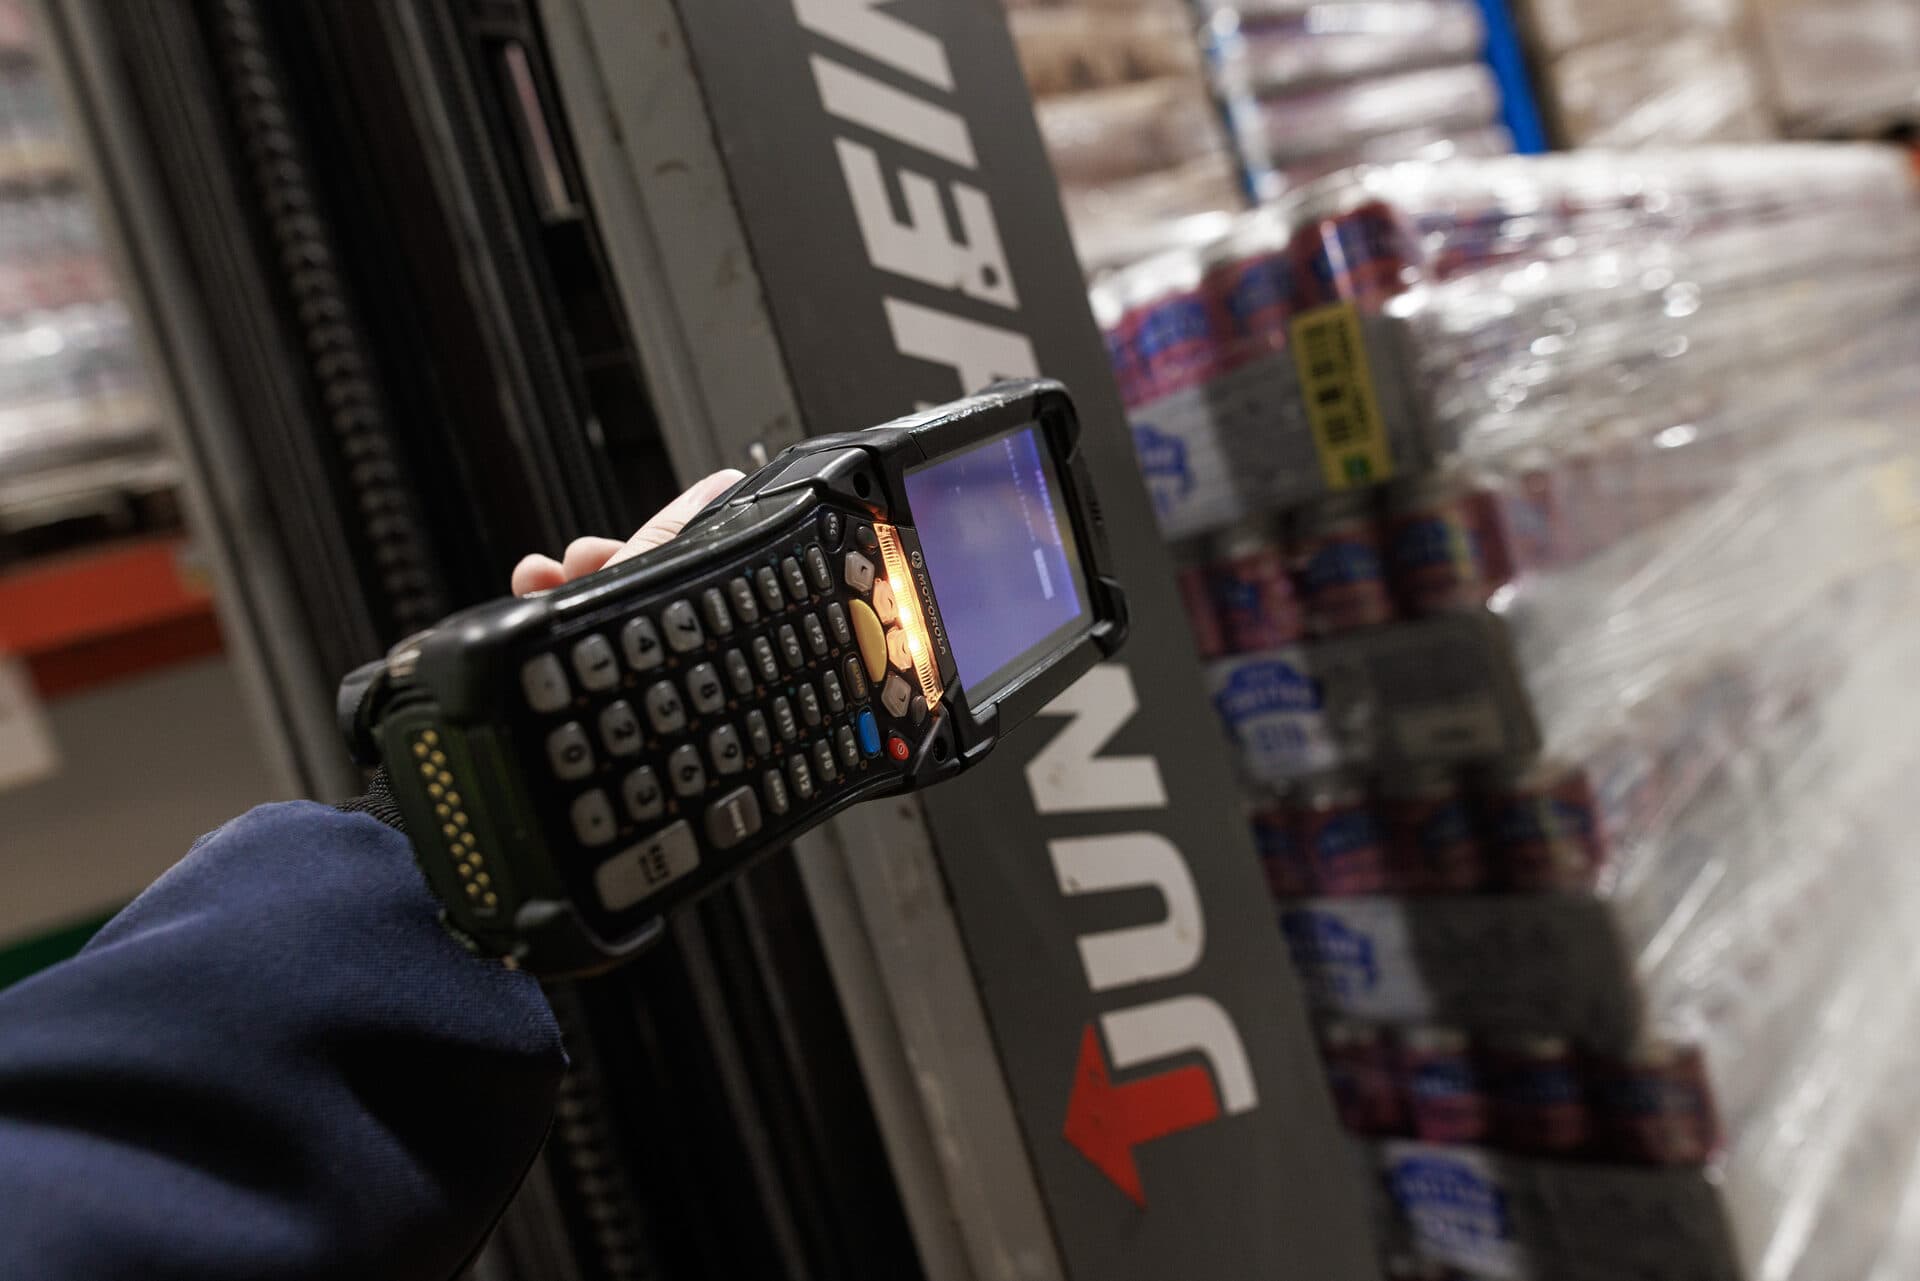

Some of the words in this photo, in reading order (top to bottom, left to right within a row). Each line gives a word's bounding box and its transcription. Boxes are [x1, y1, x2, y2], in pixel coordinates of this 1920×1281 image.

[791, 570, 804, 587] F1
[767, 579, 779, 598] F5
[739, 591, 753, 609] F9
[917, 572, 946, 655] MOTOROLA
[679, 619, 696, 631] 7
[836, 616, 846, 633] ALT
[812, 625, 824, 646] F2
[639, 637, 656, 653] 4
[786, 637, 798, 655] F6
[591, 659, 609, 671] 1
[760, 646, 775, 673] F10
[701, 683, 717, 699] 8
[830, 682, 841, 701] F3
[805, 694, 818, 711] F7
[780, 708, 793, 732] F11
[614, 720, 634, 739] 2
[564, 744, 587, 764] 0
[722, 743, 737, 758] 9
[845, 739, 856, 757] F4
[681, 765, 698, 782] 6
[797, 765, 810, 790] F12
